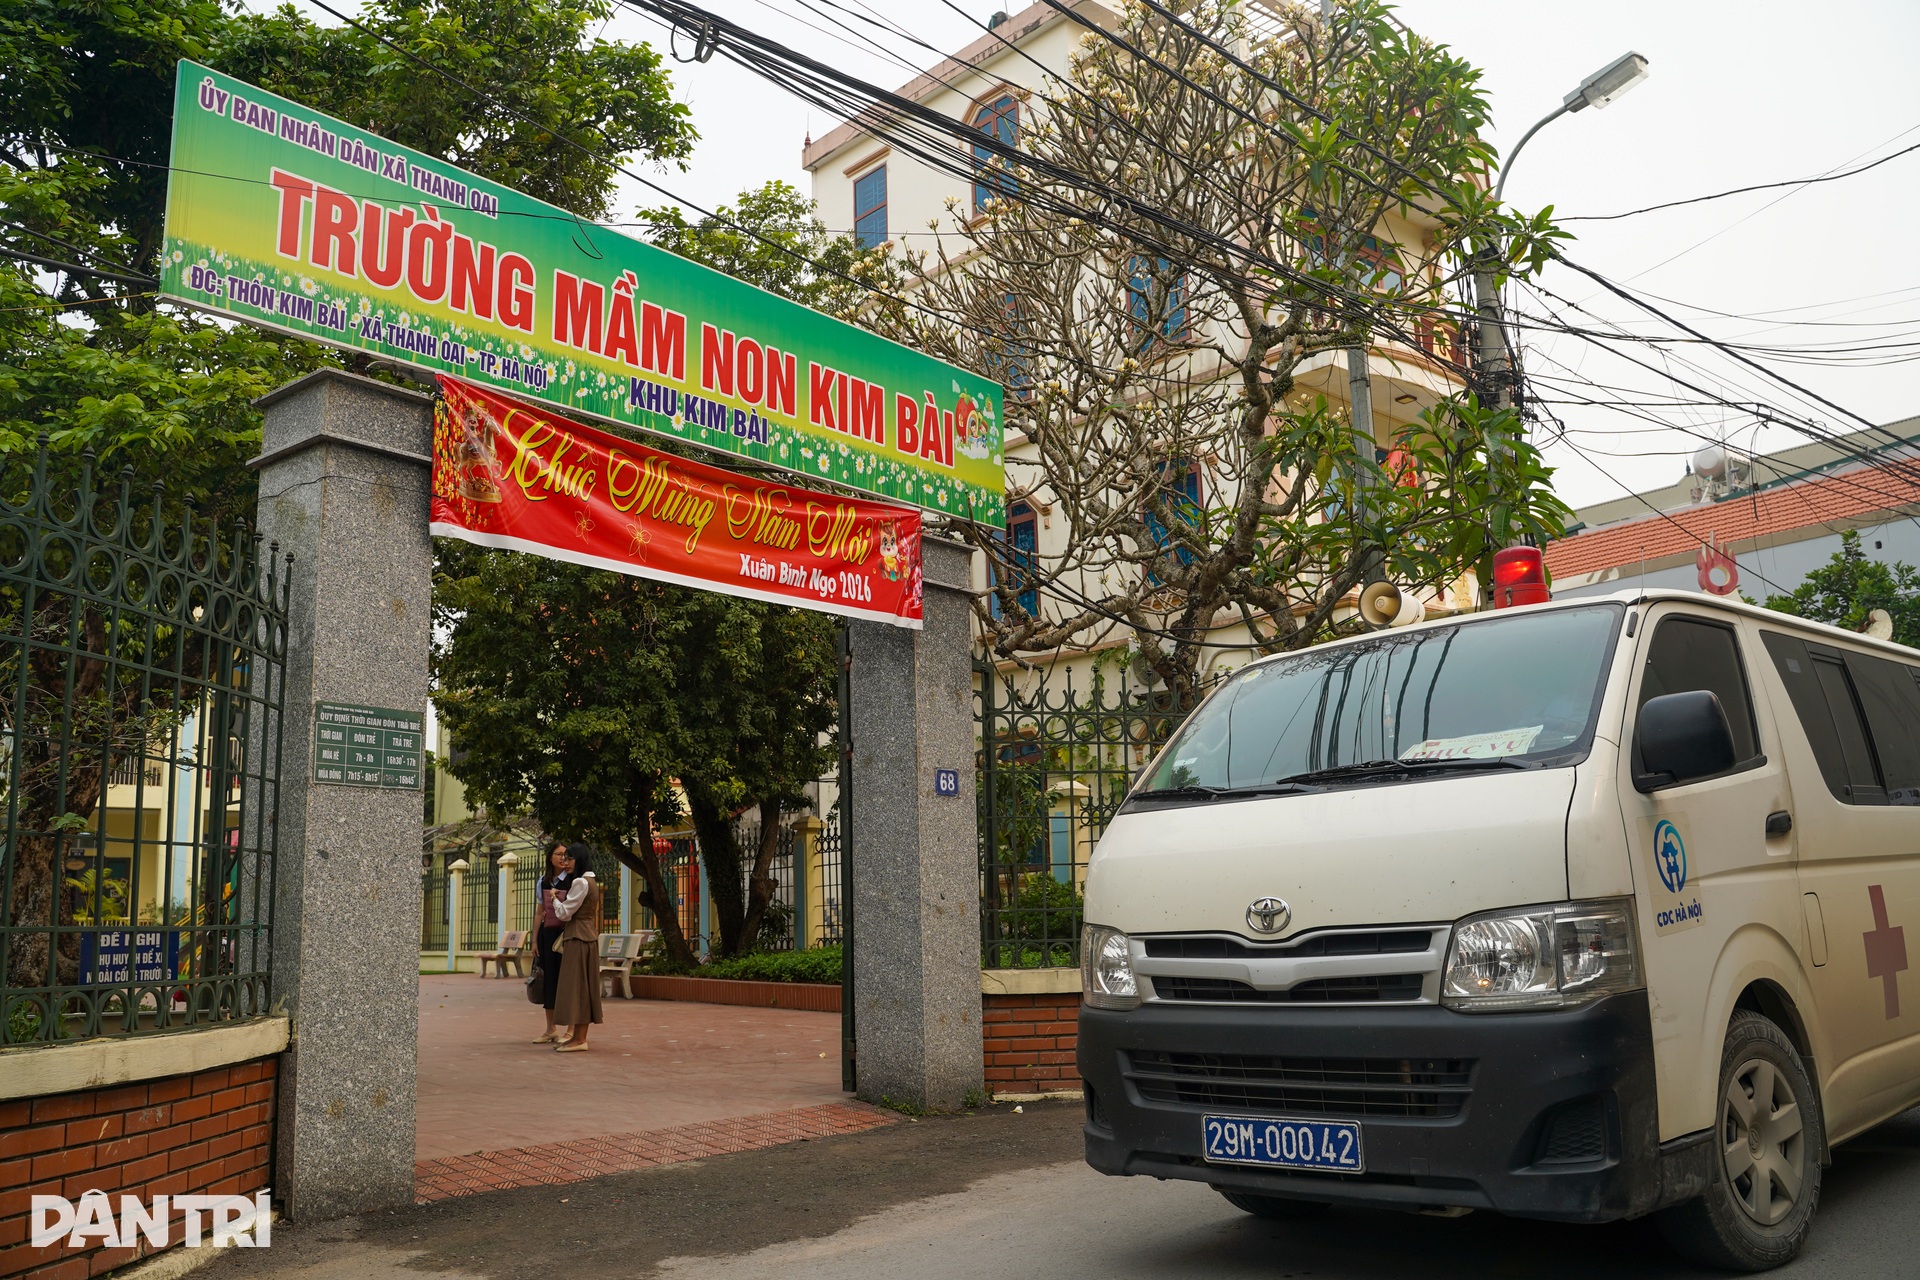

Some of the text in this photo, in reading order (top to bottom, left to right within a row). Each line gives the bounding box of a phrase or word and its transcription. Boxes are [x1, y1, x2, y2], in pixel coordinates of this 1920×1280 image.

[199, 77, 498, 218] ỦY BAN NHÂN DÂN XÃ THANH OAI
[190, 265, 223, 296] ĐC:
[227, 275, 275, 311] THÔN
[278, 291, 314, 322] KIM
[316, 302, 346, 331] BÀI
[360, 315, 383, 342] XÃ
[386, 323, 437, 358] THANH
[440, 340, 466, 366] OAI
[479, 350, 498, 375] TP.
[501, 355, 521, 382] HÀ
[523, 363, 548, 392] NỘI
[271, 168, 955, 468] TRƯỜNG MẦM NON KIM BÀI
[630, 376, 769, 445] KHU KIM BÀI
[500, 408, 874, 566] Chúc Mừng Năm Mới
[738, 553, 873, 603] Xuân Bính Ngọ 2026
[940, 773, 954, 791] 68
[1657, 898, 1702, 927] CDC HÀ NỘI
[86, 969, 112, 983] NOÀI
[139, 966, 171, 981] TRƯỜG
[112, 953, 140, 965] HUYH
[1208, 1121, 1356, 1165] 29M-000.42
